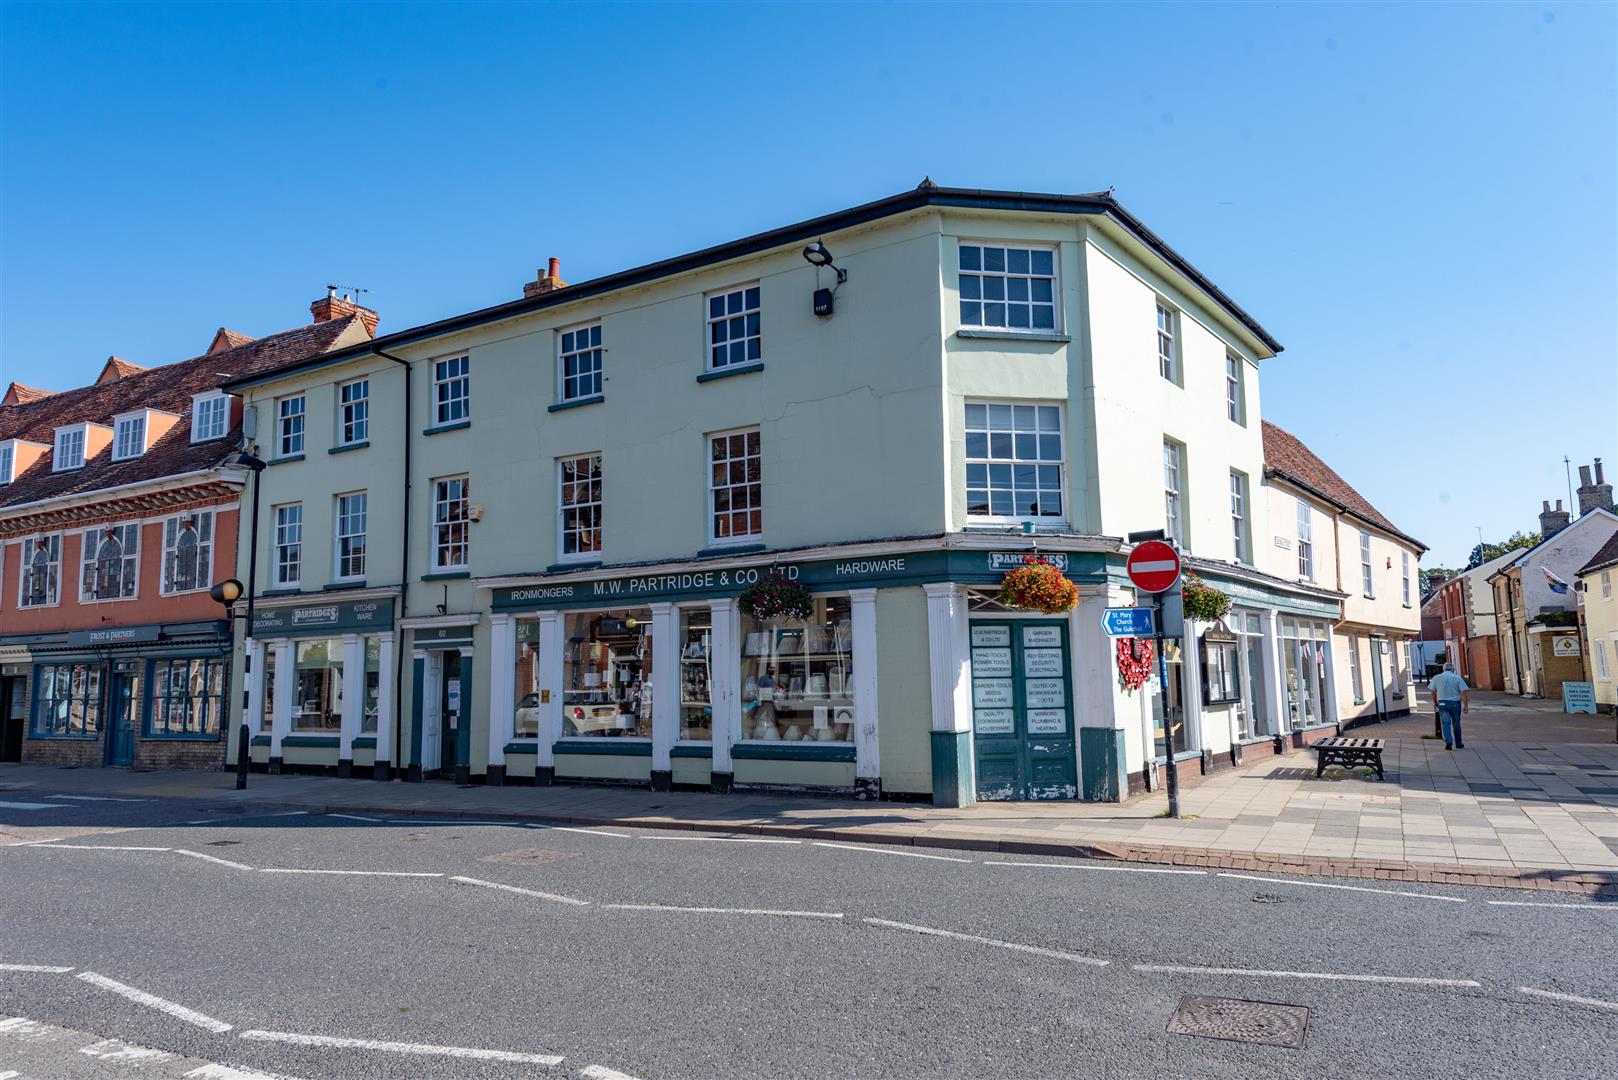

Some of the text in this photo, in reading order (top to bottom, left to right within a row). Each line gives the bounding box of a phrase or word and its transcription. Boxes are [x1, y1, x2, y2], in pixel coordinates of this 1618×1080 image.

[992, 553, 1064, 568] PARTGES
[836, 559, 905, 575] HARDWARE
[593, 581, 624, 595] M.W.
[630, 572, 714, 593] PARTRIDGE
[719, 571, 730, 586] &
[735, 569, 758, 584] CO
[511, 586, 573, 600] IRONMONGERS
[353, 603, 377, 612] KITCHEN
[261, 611, 276, 619] HOME
[294, 607, 336, 623] PARTRIDGES
[357, 612, 373, 620] WARE
[253, 619, 283, 628] DECORATING
[110, 630, 135, 641] PARTNERS
